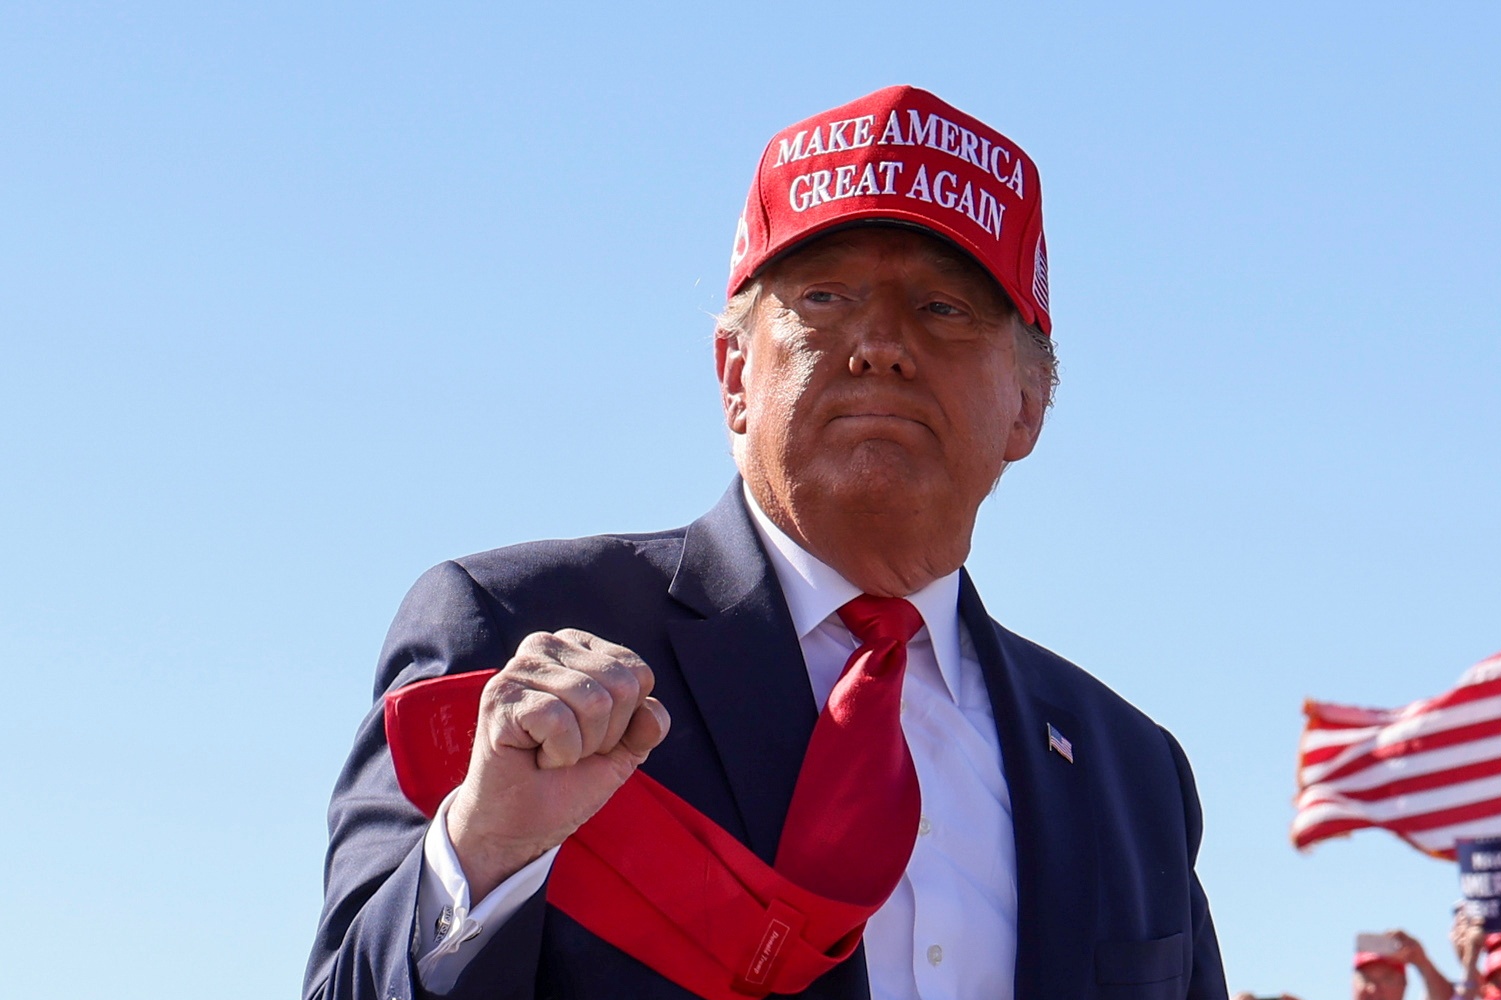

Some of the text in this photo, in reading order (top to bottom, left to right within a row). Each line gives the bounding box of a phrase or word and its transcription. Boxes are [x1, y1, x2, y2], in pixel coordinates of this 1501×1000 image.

[772, 109, 1024, 200] MAKE AMERICA
[788, 161, 1006, 242] GREAT AGAIN
